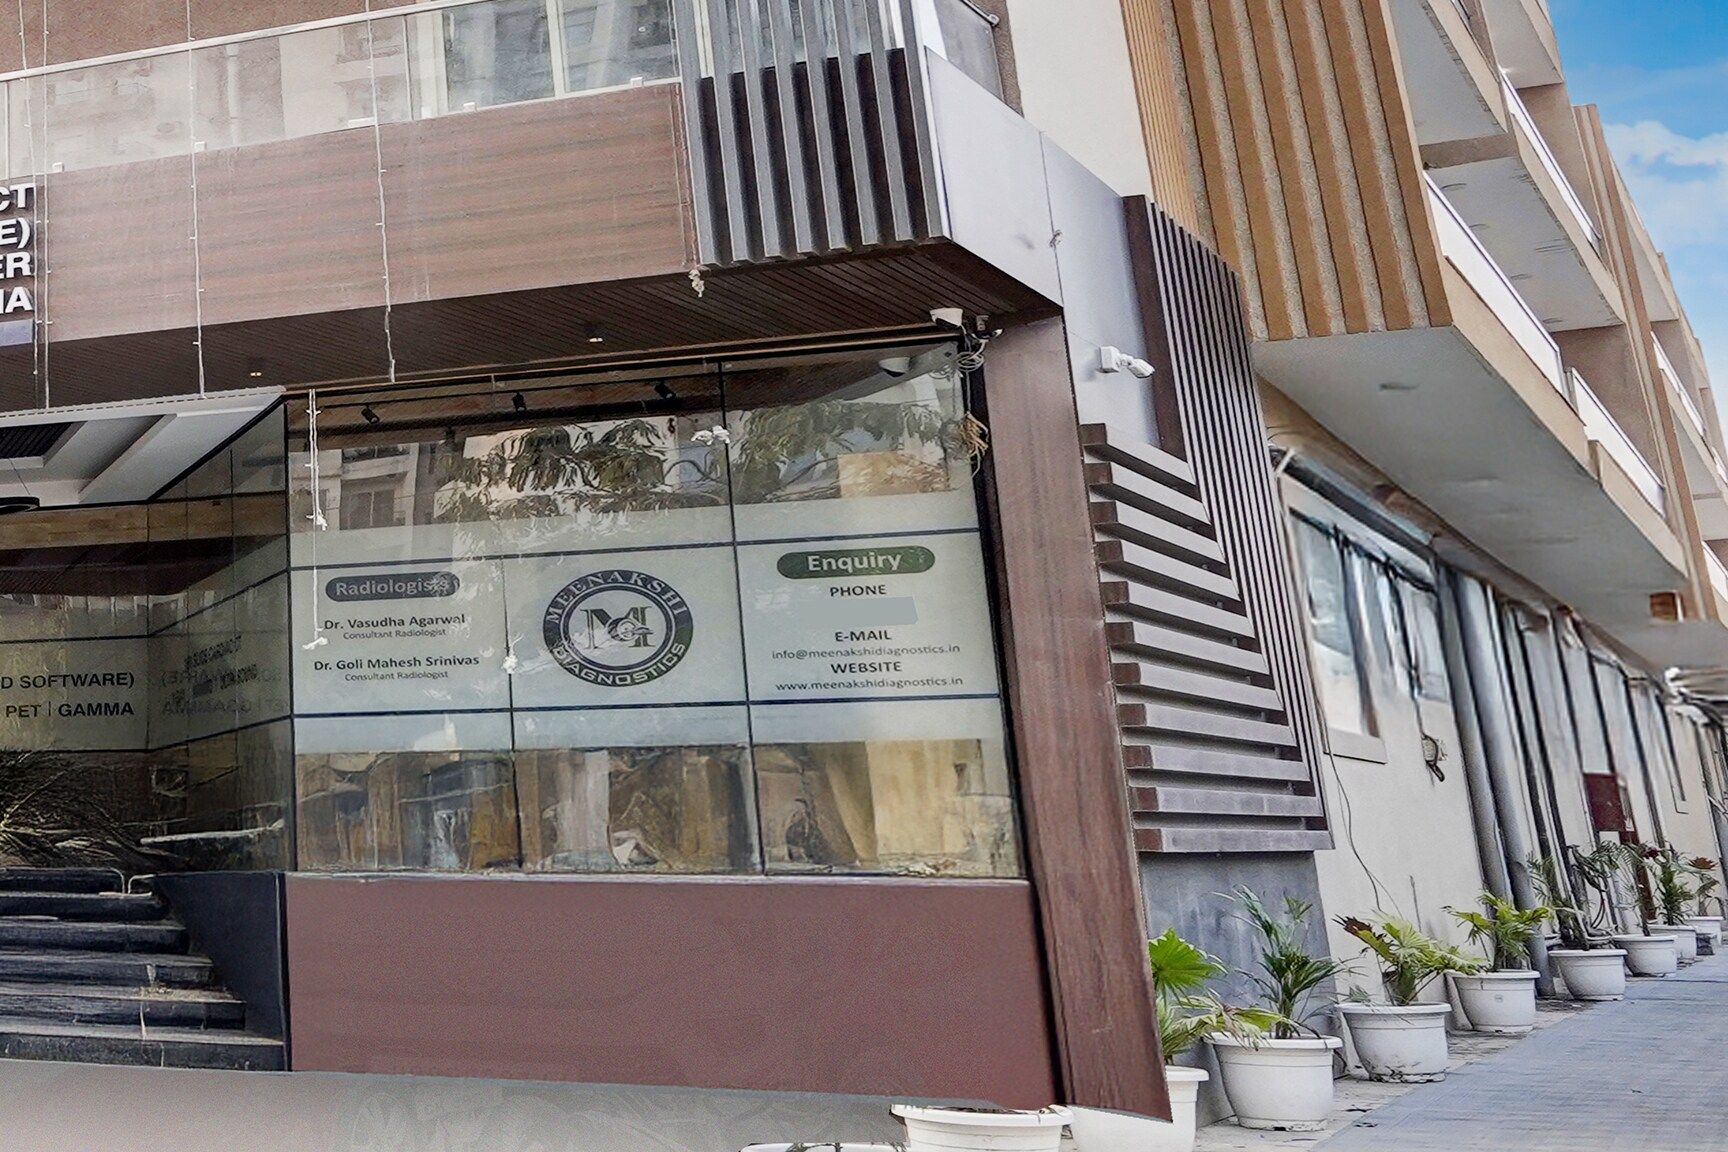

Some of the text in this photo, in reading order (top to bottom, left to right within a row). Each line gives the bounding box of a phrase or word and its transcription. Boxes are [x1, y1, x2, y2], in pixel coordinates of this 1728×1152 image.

[807, 552, 902, 573] Enquiry
[546, 571, 688, 624] MEENAKSHI
[830, 584, 887, 597] PHONE
[324, 614, 465, 629] Dr. Vasudha Agarwal
[343, 628, 446, 640] Consultant Radiologist
[835, 630, 892, 642] E-MAIL
[772, 644, 960, 660] info@meenakshidiagnostics.in
[314, 655, 480, 671] Dr. Goli Mahesh Srinivas
[552, 642, 686, 685] DIAGNOSTICS
[831, 661, 902, 674] WEBSITE
[19, 671, 135, 689] SOFTWARE)
[345, 670, 449, 682] Consultant Radiologist
[775, 677, 963, 691] www.meenakshidiagnostics.in
[5, 704, 42, 718] PET
[58, 702, 134, 717] GAMMA
